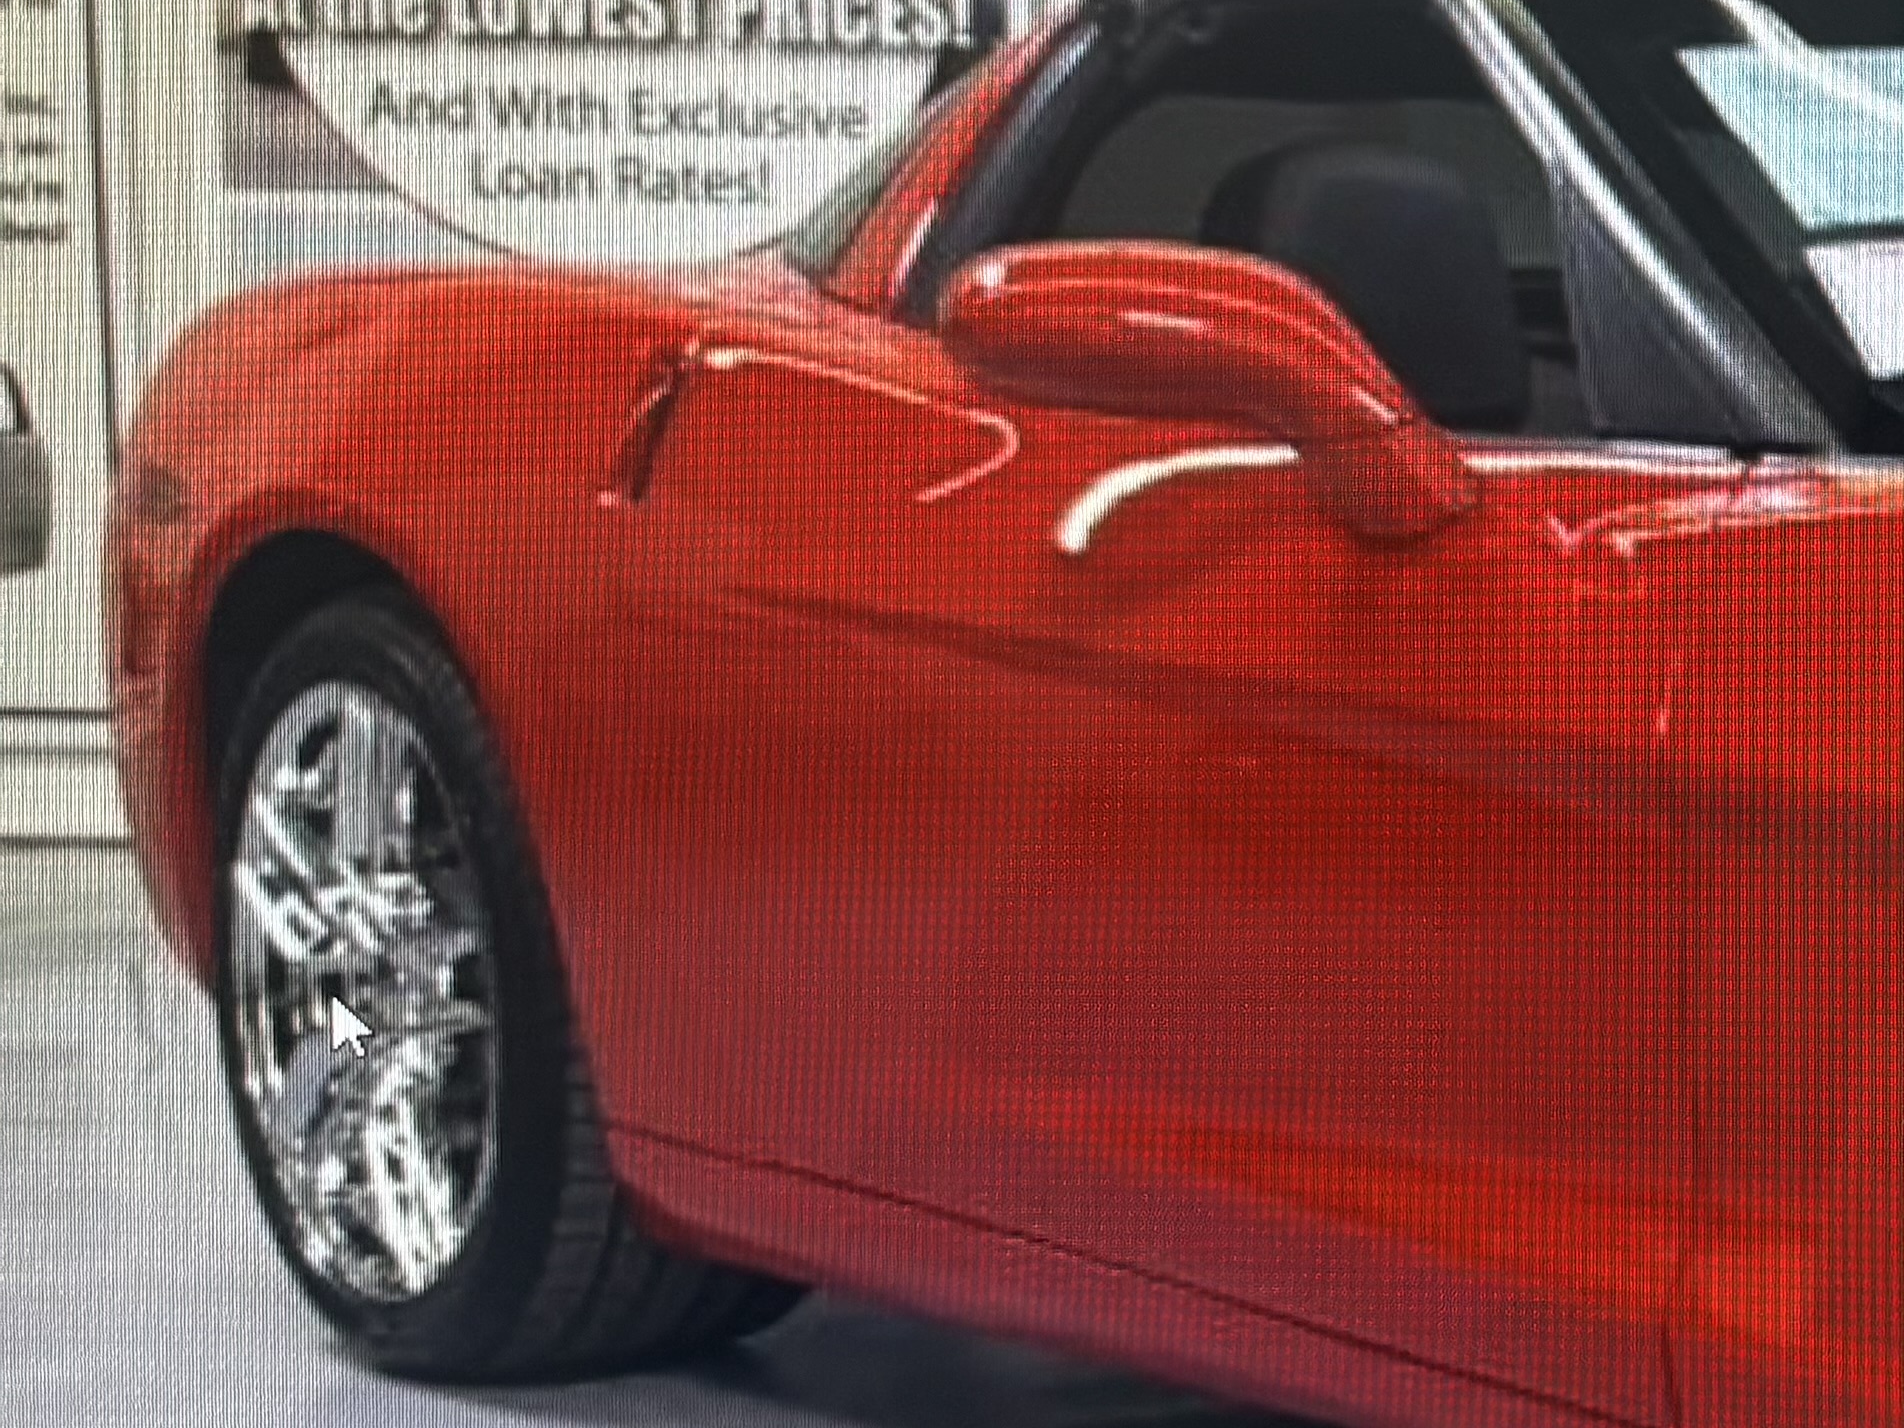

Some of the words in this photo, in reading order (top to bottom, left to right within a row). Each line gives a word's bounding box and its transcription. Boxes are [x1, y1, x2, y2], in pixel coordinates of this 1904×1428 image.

[365, 81, 474, 128] And
[486, 81, 609, 132] With
[628, 85, 868, 140] Exclusive
[470, 155, 596, 200] Loan
[614, 157, 771, 206] Rates!
